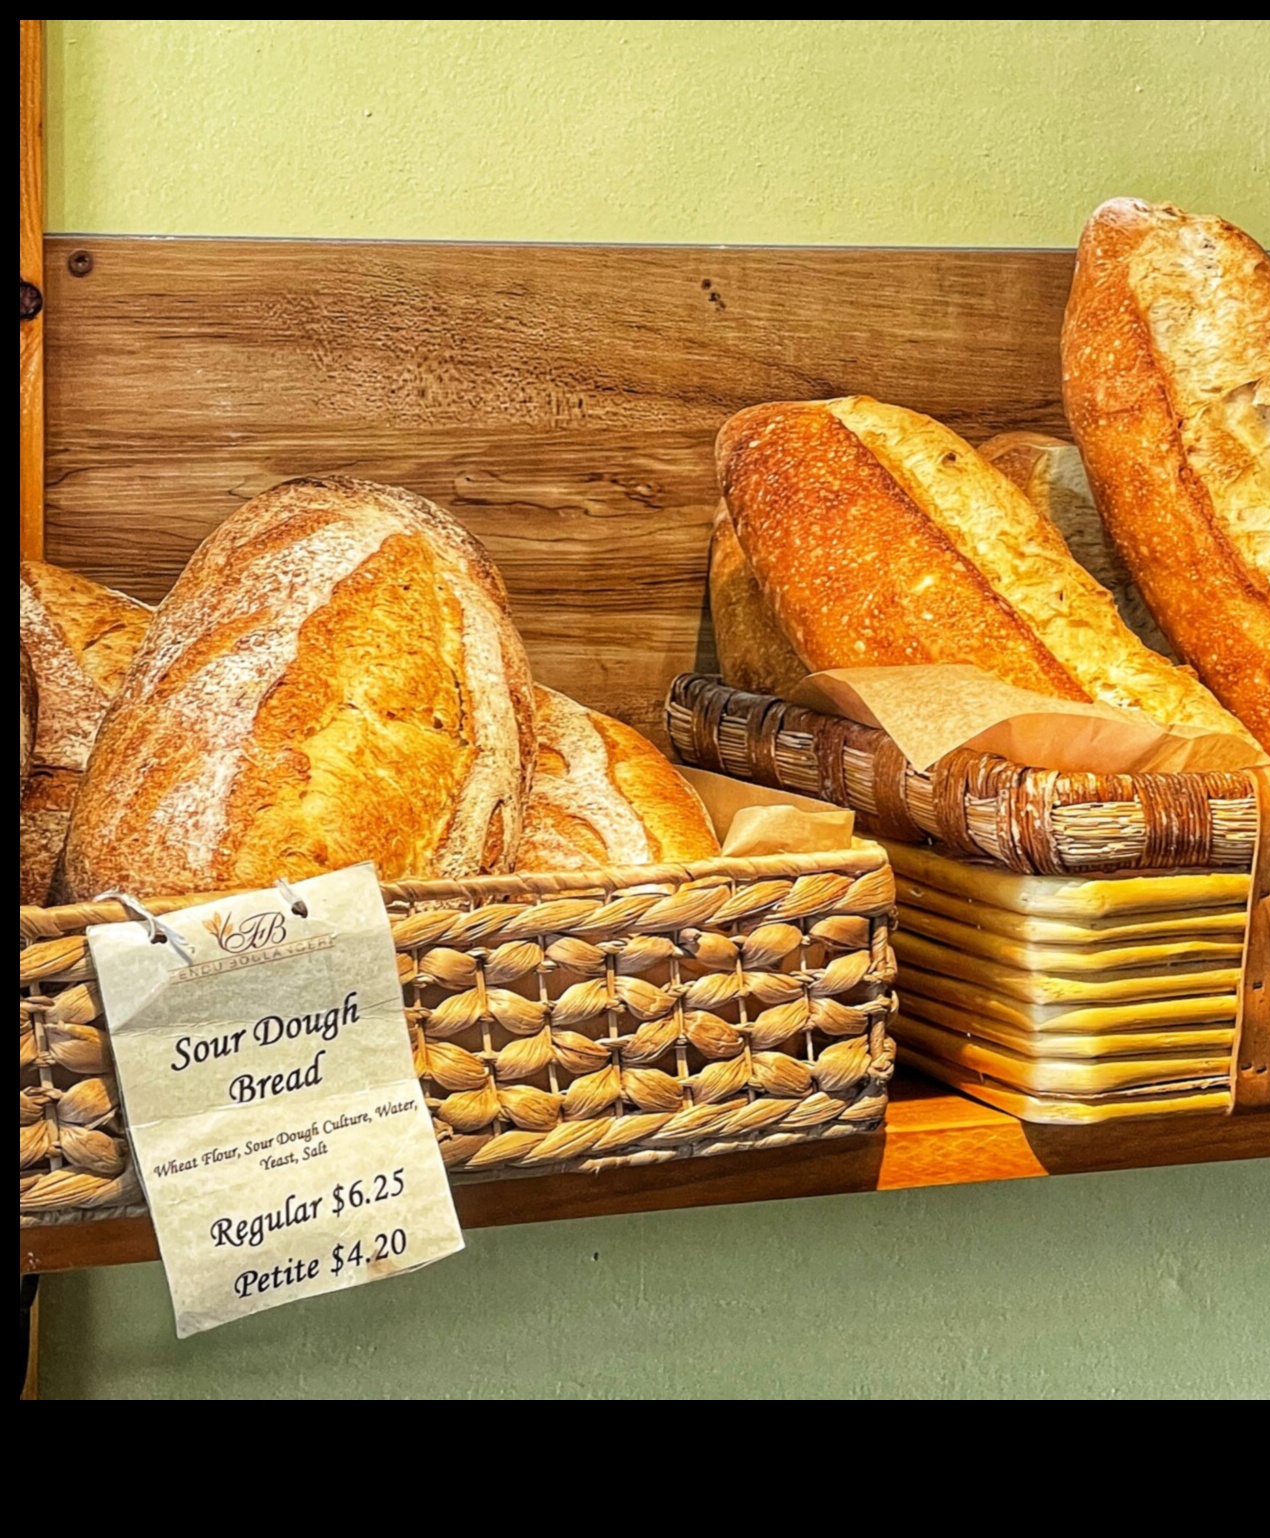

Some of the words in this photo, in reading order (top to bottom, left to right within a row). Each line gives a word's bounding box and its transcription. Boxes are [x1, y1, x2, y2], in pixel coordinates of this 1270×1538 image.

[170, 1029, 246, 1072] Sour
[253, 991, 360, 1049] Dough
[229, 1050, 324, 1104] Bread
[154, 1157, 198, 1179] Wheat
[201, 1145, 241, 1166] Flour,
[244, 1137, 275, 1156] Sour
[276, 1121, 320, 1145] Dough
[323, 1111, 373, 1135] Culture,
[375, 1098, 418, 1119] Water,
[260, 1152, 299, 1171] Yeast,
[302, 1142, 329, 1161] Salt
[210, 1194, 324, 1248] Regular
[331, 1167, 405, 1217] $6.25
[234, 1256, 320, 1299] Petite
[330, 1228, 408, 1276] $4.20
